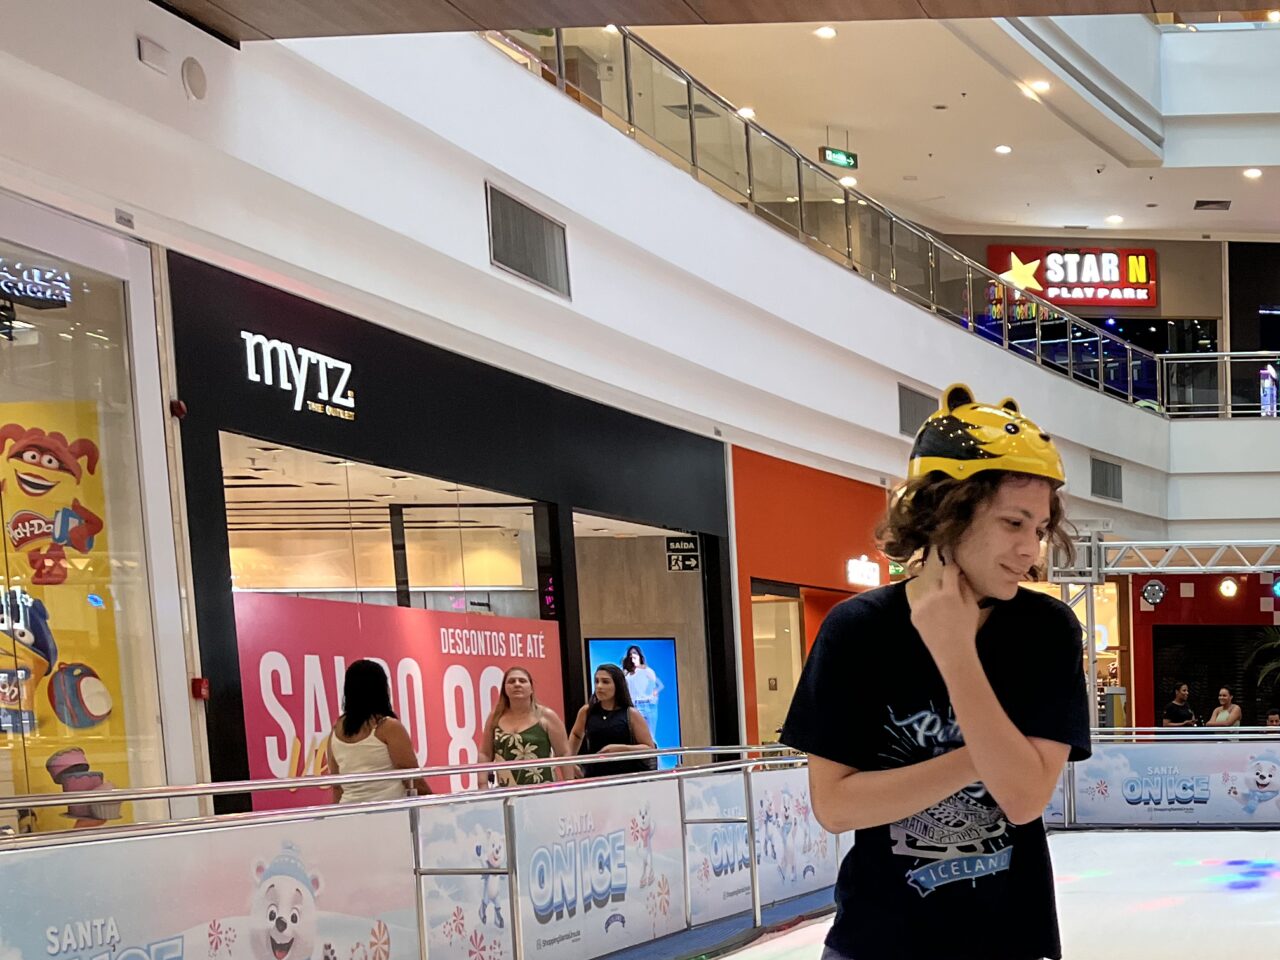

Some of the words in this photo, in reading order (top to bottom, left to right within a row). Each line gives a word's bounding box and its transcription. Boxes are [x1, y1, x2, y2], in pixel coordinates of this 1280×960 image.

[1046, 252, 1120, 283] STAR
[1128, 255, 1147, 283] N
[669, 541, 695, 550] SAÍDA
[440, 627, 506, 657] DESCONTOS
[509, 632, 524, 657] DE
[526, 631, 546, 659] ATÉ
[1147, 766, 1180, 776] SANTA
[1122, 775, 1162, 805] ON
[1165, 775, 1211, 804] ICE
[558, 811, 596, 838] SANTA
[529, 839, 577, 919] ON
[580, 829, 628, 904] ICE
[928, 852, 1010, 882] ICELAND
[46, 916, 121, 956] SANTA
